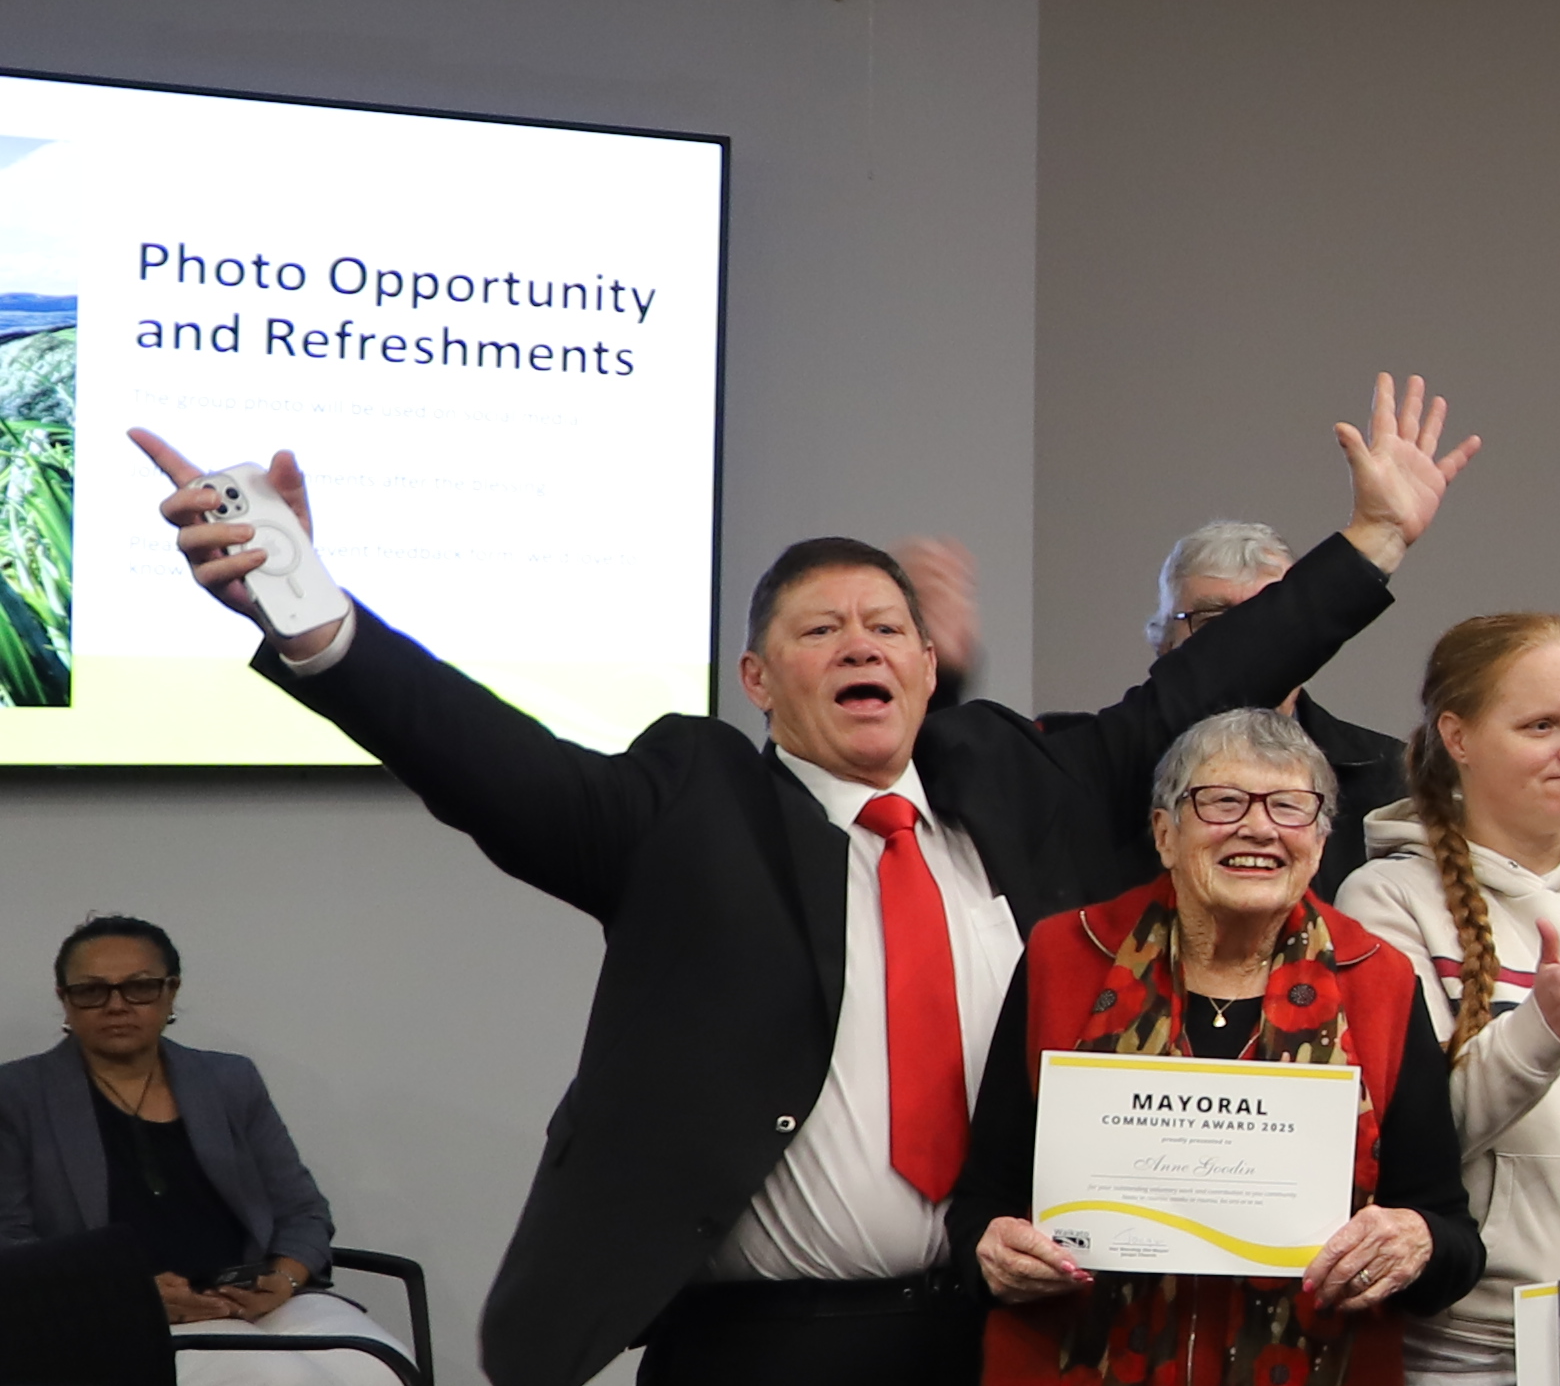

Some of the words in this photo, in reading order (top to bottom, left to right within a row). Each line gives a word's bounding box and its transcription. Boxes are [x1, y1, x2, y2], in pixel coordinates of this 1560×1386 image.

[140, 242, 306, 291] Photo
[329, 257, 656, 324] Opportunity
[136, 313, 240, 353] and
[266, 318, 634, 376] Refreshments
[134, 389, 169, 405] The
[177, 393, 236, 410] group
[244, 397, 303, 412] photo
[311, 400, 342, 414] will
[352, 401, 373, 415] be
[382, 405, 426, 418] used
[433, 408, 456, 419] on
[382, 475, 426, 489] after
[435, 477, 464, 490] the
[376, 544, 462, 560] feedback
[130, 562, 184, 576] know
[1131, 1092, 1268, 1116] MAYORAL
[1101, 1114, 1196, 1129] COMMUNITY
[1201, 1119, 1255, 1132] AWARD
[1261, 1122, 1296, 1134] 2025
[1133, 1154, 1189, 1172] Anne
